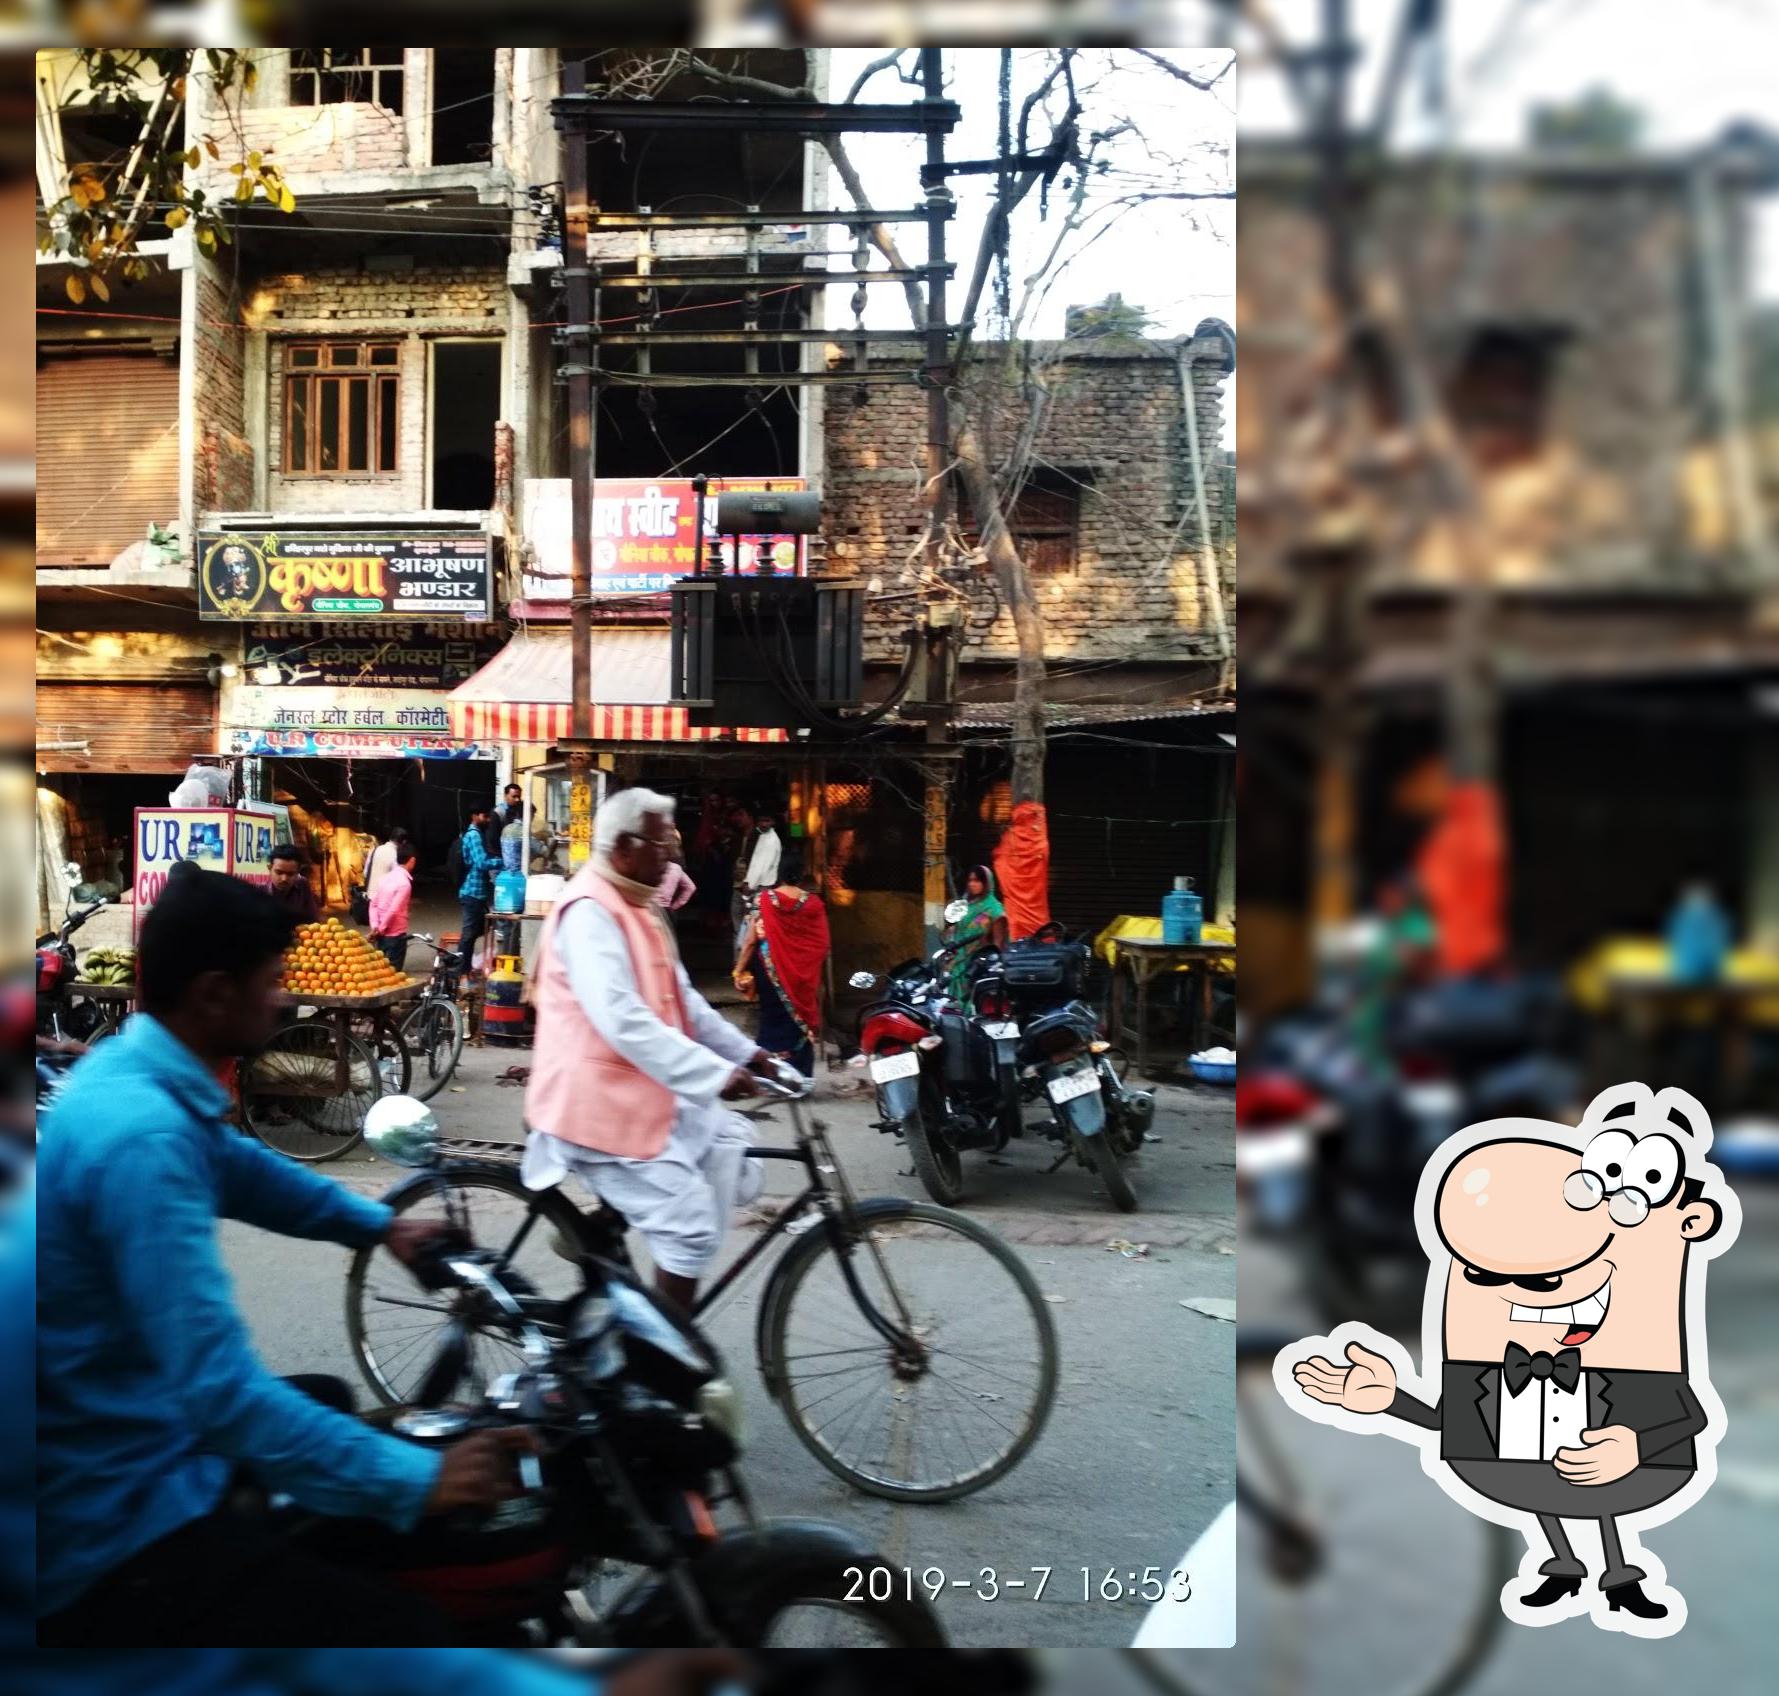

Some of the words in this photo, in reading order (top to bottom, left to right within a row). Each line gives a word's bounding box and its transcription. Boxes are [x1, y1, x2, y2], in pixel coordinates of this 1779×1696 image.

[390, 557, 486, 579] आभूषण
[267, 557, 388, 612] कृष्णा
[399, 582, 477, 598] भण्डार
[273, 706, 315, 725] जेनरल
[140, 819, 184, 862] UR
[235, 821, 255, 864] UR
